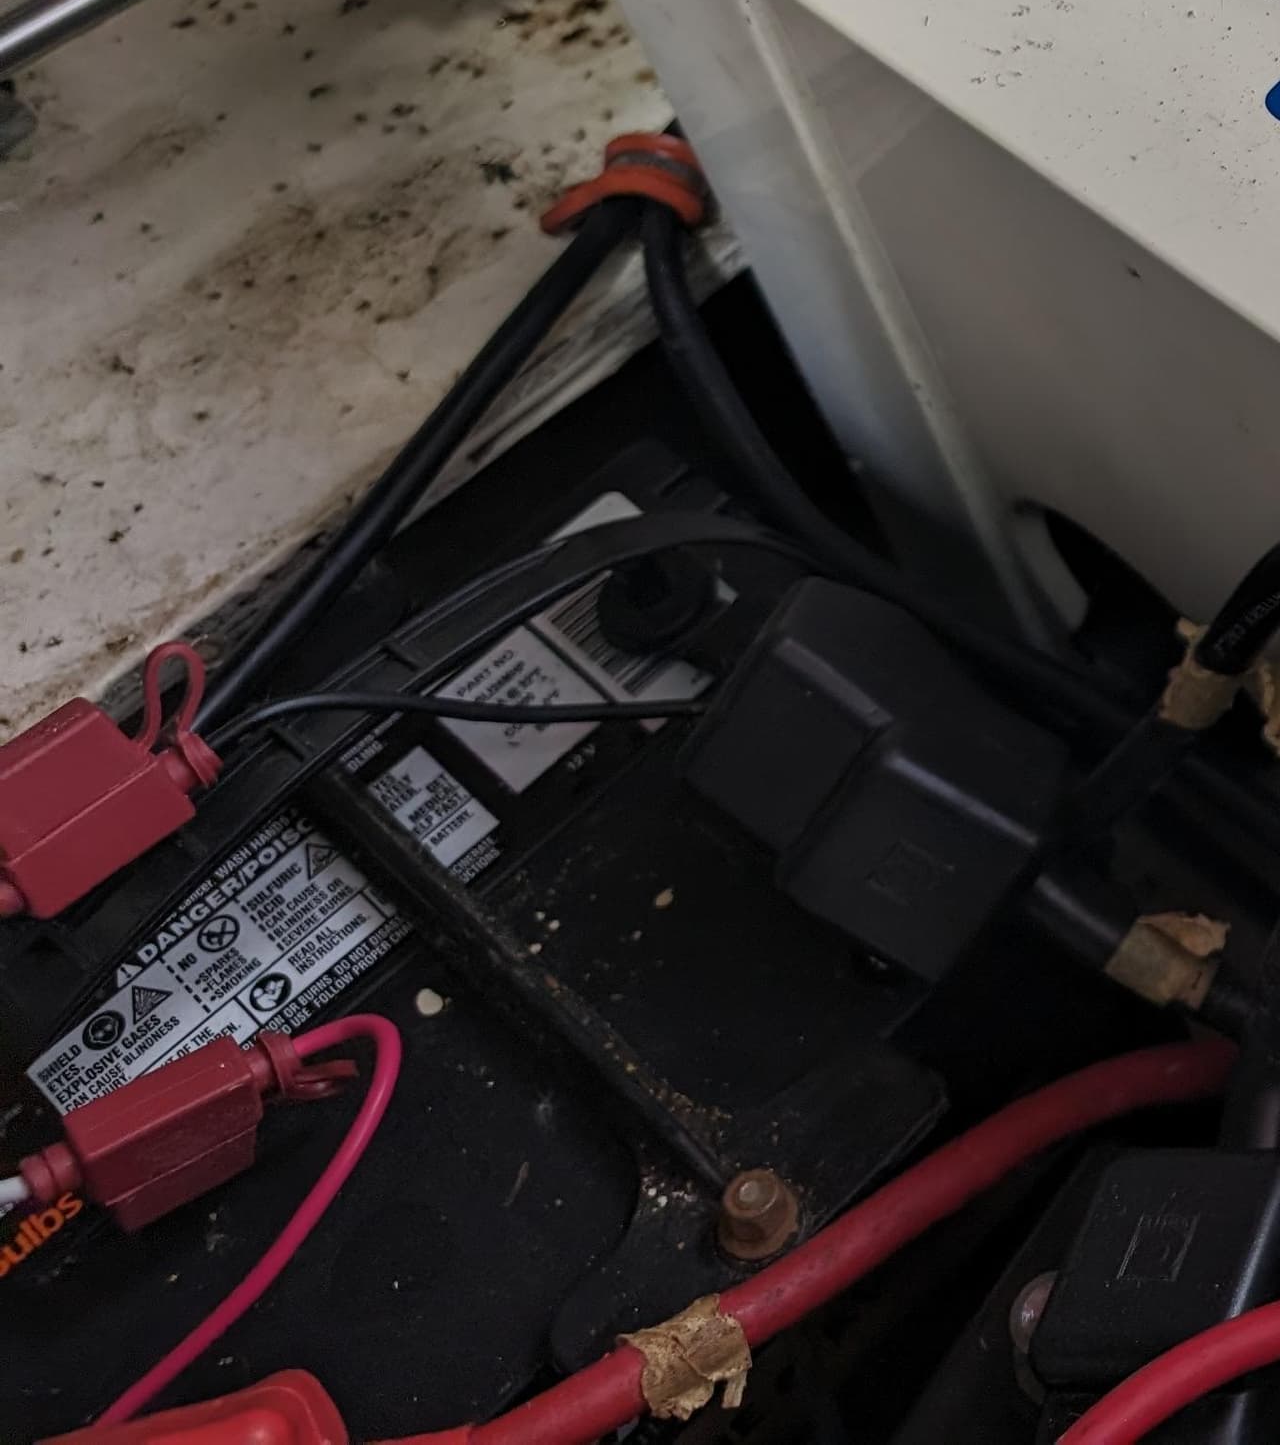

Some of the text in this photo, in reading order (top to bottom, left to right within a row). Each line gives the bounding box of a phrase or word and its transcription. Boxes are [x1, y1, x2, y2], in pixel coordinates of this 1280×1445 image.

[408, 783, 459, 824] MEDICAL
[214, 848, 252, 880] WASH
[137, 817, 314, 965] DANGER/POISO
[249, 862, 303, 912] SULFURIC
[287, 882, 320, 913] CAUSE
[258, 893, 287, 922] ACID
[273, 890, 330, 940] BLINDNESS
[282, 914, 322, 948] SEVERE
[295, 913, 370, 976] INSTRUCTIONS.
[177, 953, 198, 973] NO
[287, 940, 317, 966] READ
[313, 972, 356, 1009] FOLLOW
[55, 1045, 123, 1105] EXPLOSIVE
[120, 1013, 162, 1053] GASES
[123, 1015, 181, 1067] BLINDNESS
[38, 1044, 82, 1084] SHIELD
[48, 1064, 86, 1093] EYES.
